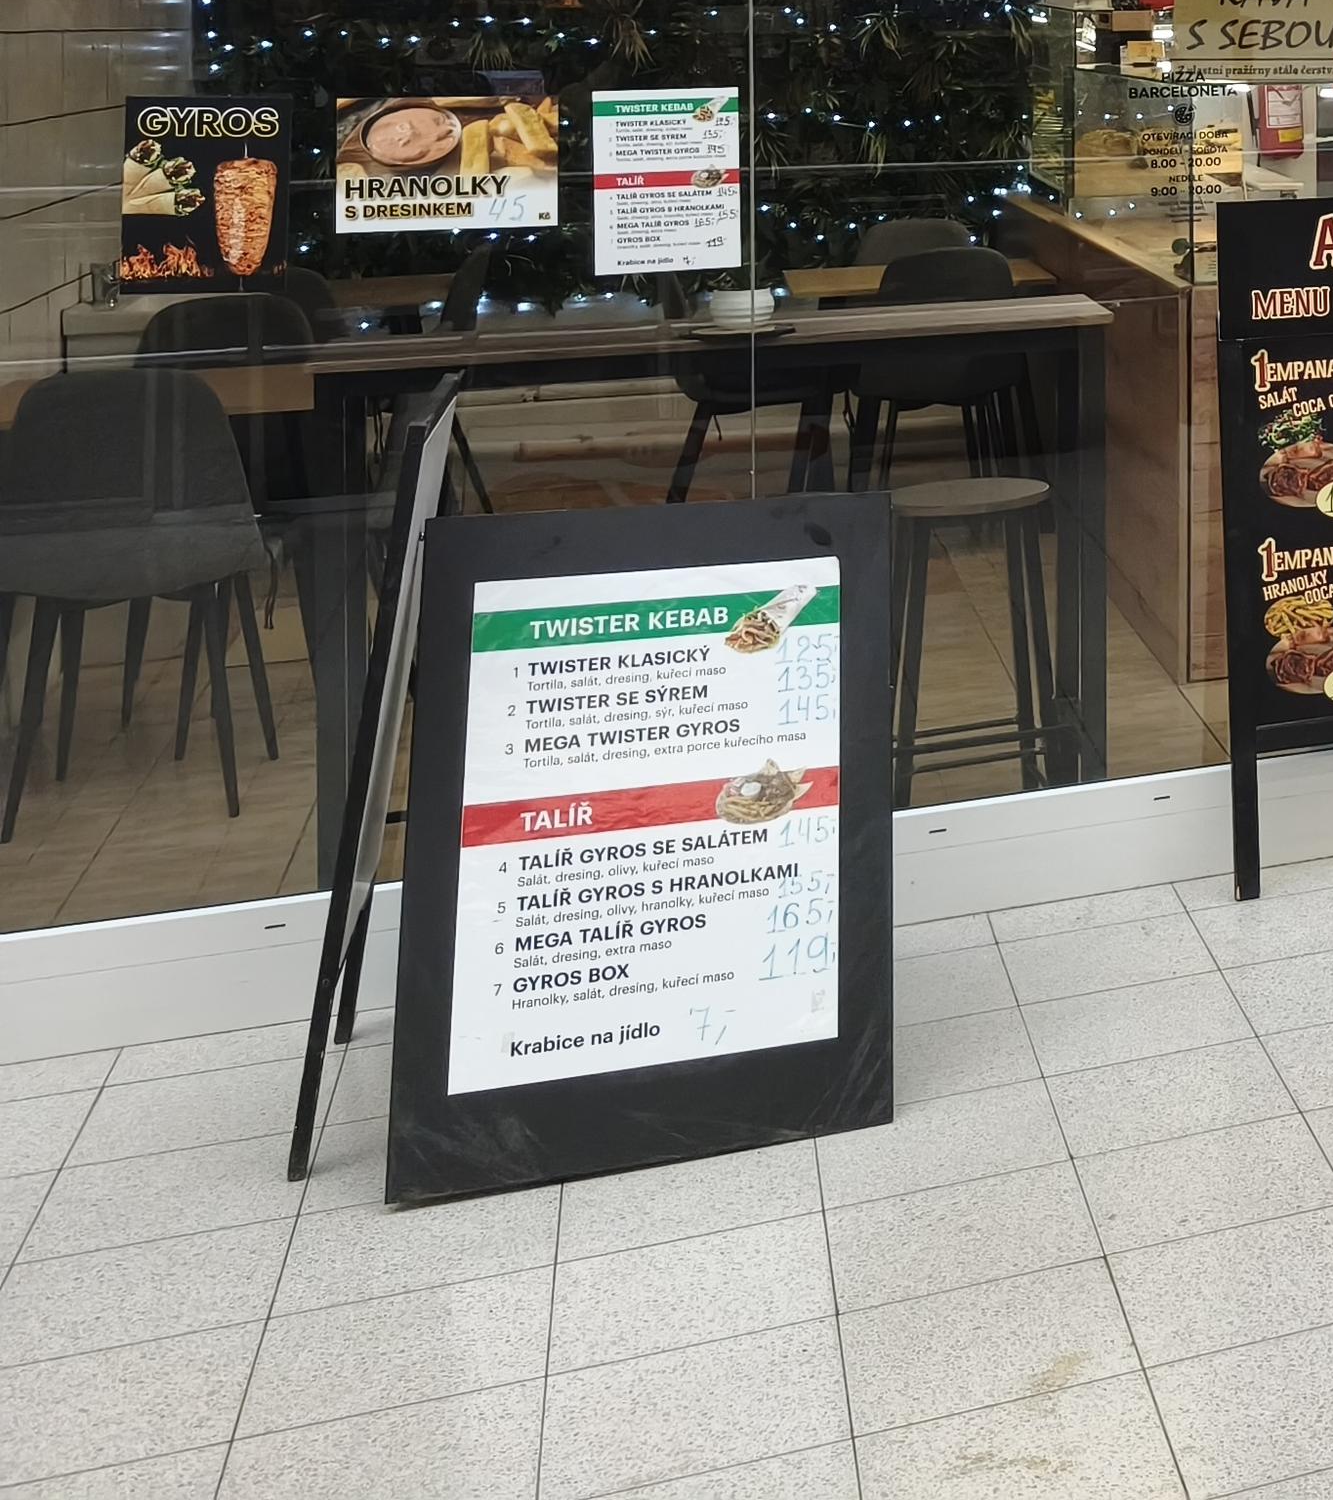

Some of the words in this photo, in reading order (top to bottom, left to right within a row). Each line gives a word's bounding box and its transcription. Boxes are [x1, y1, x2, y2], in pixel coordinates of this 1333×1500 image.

[1186, 19, 1207, 50] S
[1128, 85, 1238, 99] BARCELONETA
[1162, 72, 1205, 82] PIZZA
[137, 106, 280, 138] GYROS
[614, 104, 658, 113] TWISTER
[661, 103, 694, 111] KEBAB
[1150, 157, 1177, 169] 8.00
[1188, 156, 1222, 168] 20.00
[344, 174, 509, 200] HRANOLKY
[616, 176, 644, 186] TALÍŘ
[344, 205, 356, 218] S
[362, 202, 473, 218] DRESINKEM
[1252, 287, 1330, 320] MENU
[1258, 387, 1297, 409] SALÁT
[1292, 397, 1325, 418] COCA
[1262, 570, 1328, 601] HRANOLKY
[530, 615, 639, 639] TWISTER
[649, 607, 729, 630] KEBAB
[513, 666, 519, 678] 1
[528, 655, 611, 677] TWISTER
[618, 648, 710, 669] KLASICKÝ
[527, 679, 567, 692] Tortila,
[571, 676, 601, 687] salát,
[605, 672, 651, 686] dresing,
[656, 667, 691, 679] kuřecí
[695, 665, 726, 676] maso
[508, 705, 515, 717] 2
[526, 694, 609, 715] TWISTER
[616, 690, 639, 705] SE
[645, 685, 708, 702] SÝREM
[505, 744, 514, 755] 3
[524, 733, 580, 753] MEGA
[588, 726, 670, 747] TWISTER
[676, 719, 740, 738] GYROS
[524, 755, 564, 769] Tortila,
[568, 751, 598, 765] salát,
[603, 747, 650, 762] dresing,
[654, 744, 683, 755] extra
[687, 740, 720, 755] porce
[724, 734, 774, 748] kuřecího
[777, 731, 806, 742] masa
[520, 803, 593, 832] TALÍŘ
[499, 862, 508, 873] 4
[519, 848, 573, 871] TALÍŘ
[580, 844, 646, 864] GYROS
[653, 840, 676, 854] SE
[681, 828, 769, 851] SALÁTEM
[497, 901, 506, 914] 5
[518, 888, 572, 911] TALÍŘ
[578, 883, 645, 904] GYROS
[652, 880, 663, 894] S
[670, 863, 798, 892] HRANOLKAMI
[495, 943, 504, 955] 6
[515, 931, 572, 952] MEGA
[580, 920, 633, 944] TALÍŘ
[640, 914, 707, 935] GYROS
[494, 984, 502, 996] 7
[513, 971, 582, 993] GYROS
[589, 964, 630, 982] BOX
[510, 1034, 585, 1057] Krabice
[591, 1031, 613, 1046] na
[619, 1022, 661, 1044] jídlo
